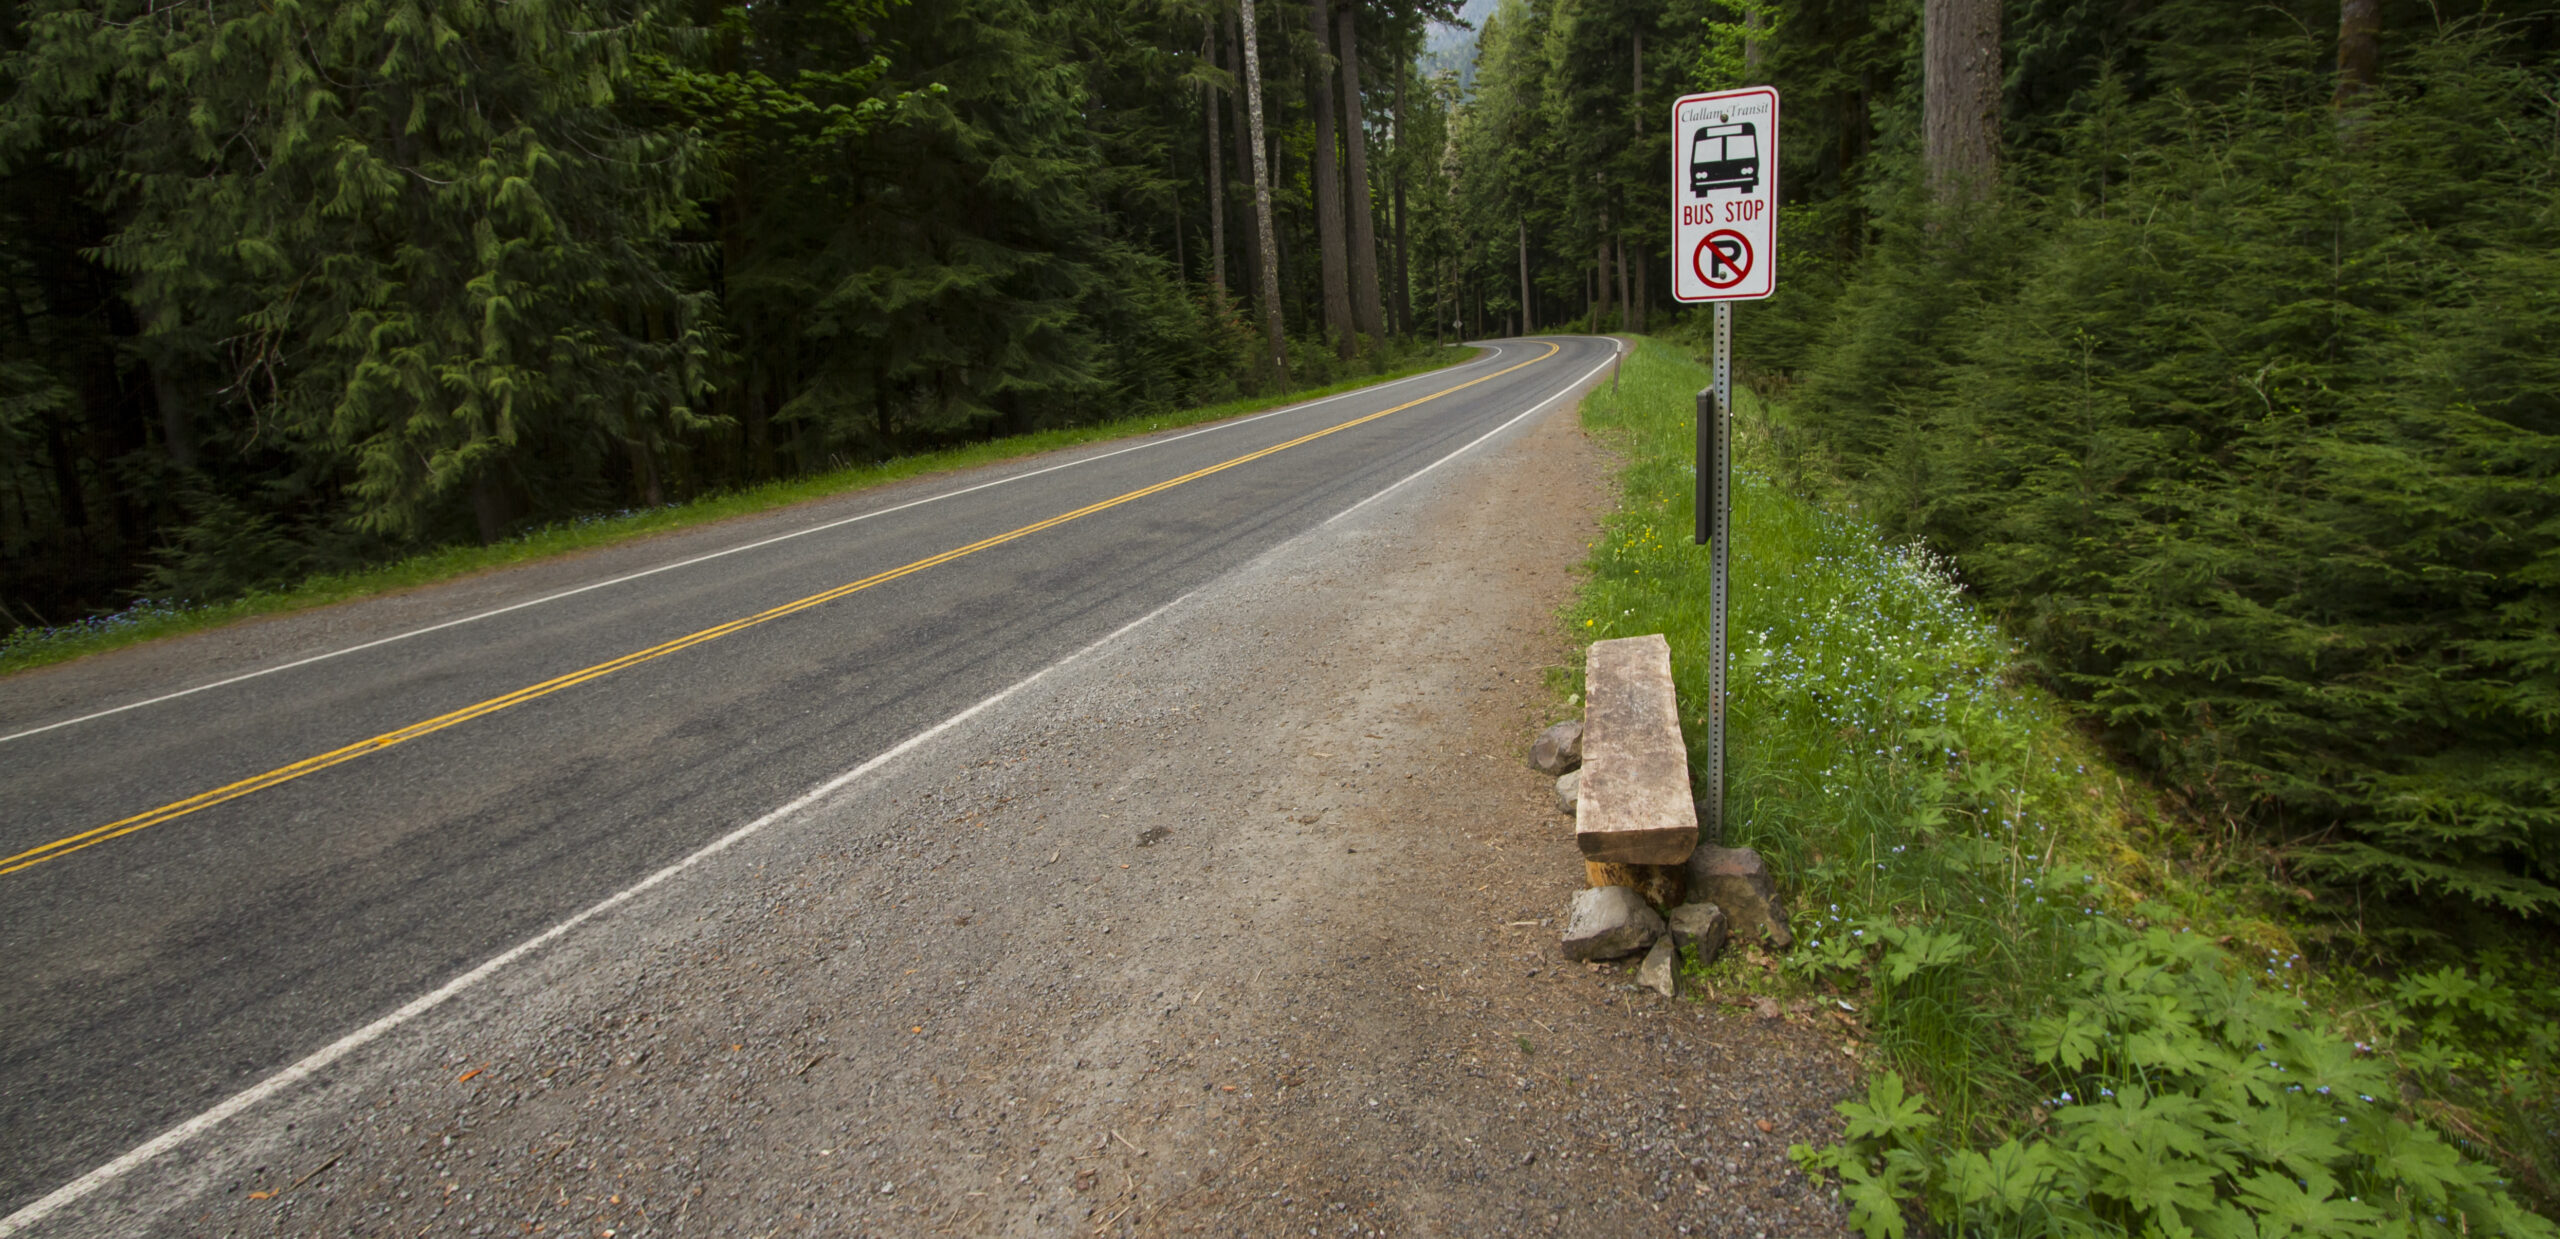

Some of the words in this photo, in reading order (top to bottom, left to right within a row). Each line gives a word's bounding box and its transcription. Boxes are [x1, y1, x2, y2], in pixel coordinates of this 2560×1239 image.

[1681, 107, 1724, 123] Clallam
[1727, 102, 1769, 117] Transit
[1684, 203, 1714, 226] BUS
[1725, 199, 1765, 223] STOP
[1711, 239, 1742, 278] P
